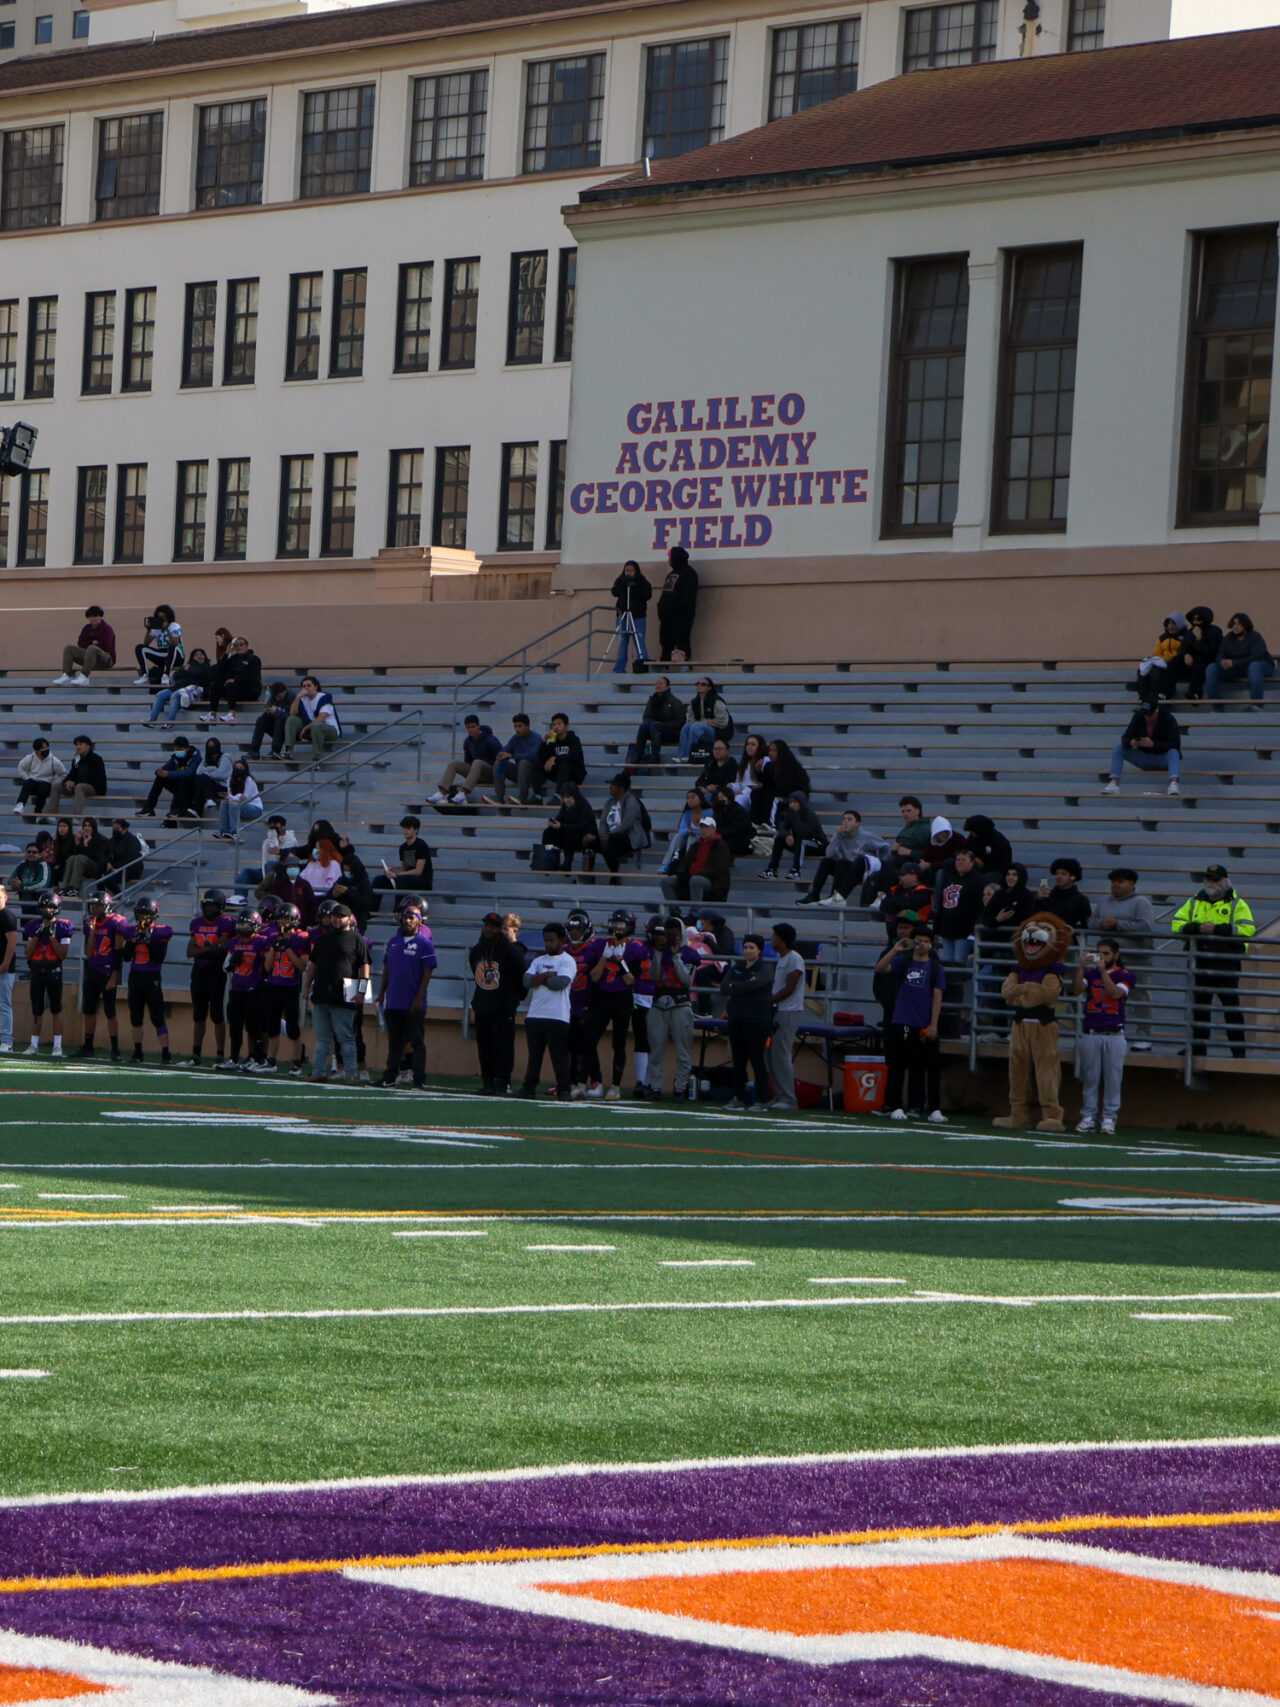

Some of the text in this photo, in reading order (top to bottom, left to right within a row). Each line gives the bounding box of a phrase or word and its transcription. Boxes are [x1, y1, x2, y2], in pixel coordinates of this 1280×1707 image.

[627, 393, 805, 434] GALILEO
[616, 432, 816, 474] ACADEMY
[570, 469, 869, 514] GEORGE WHITE
[652, 514, 773, 550] FIELD
[861, 1072, 875, 1088] G
